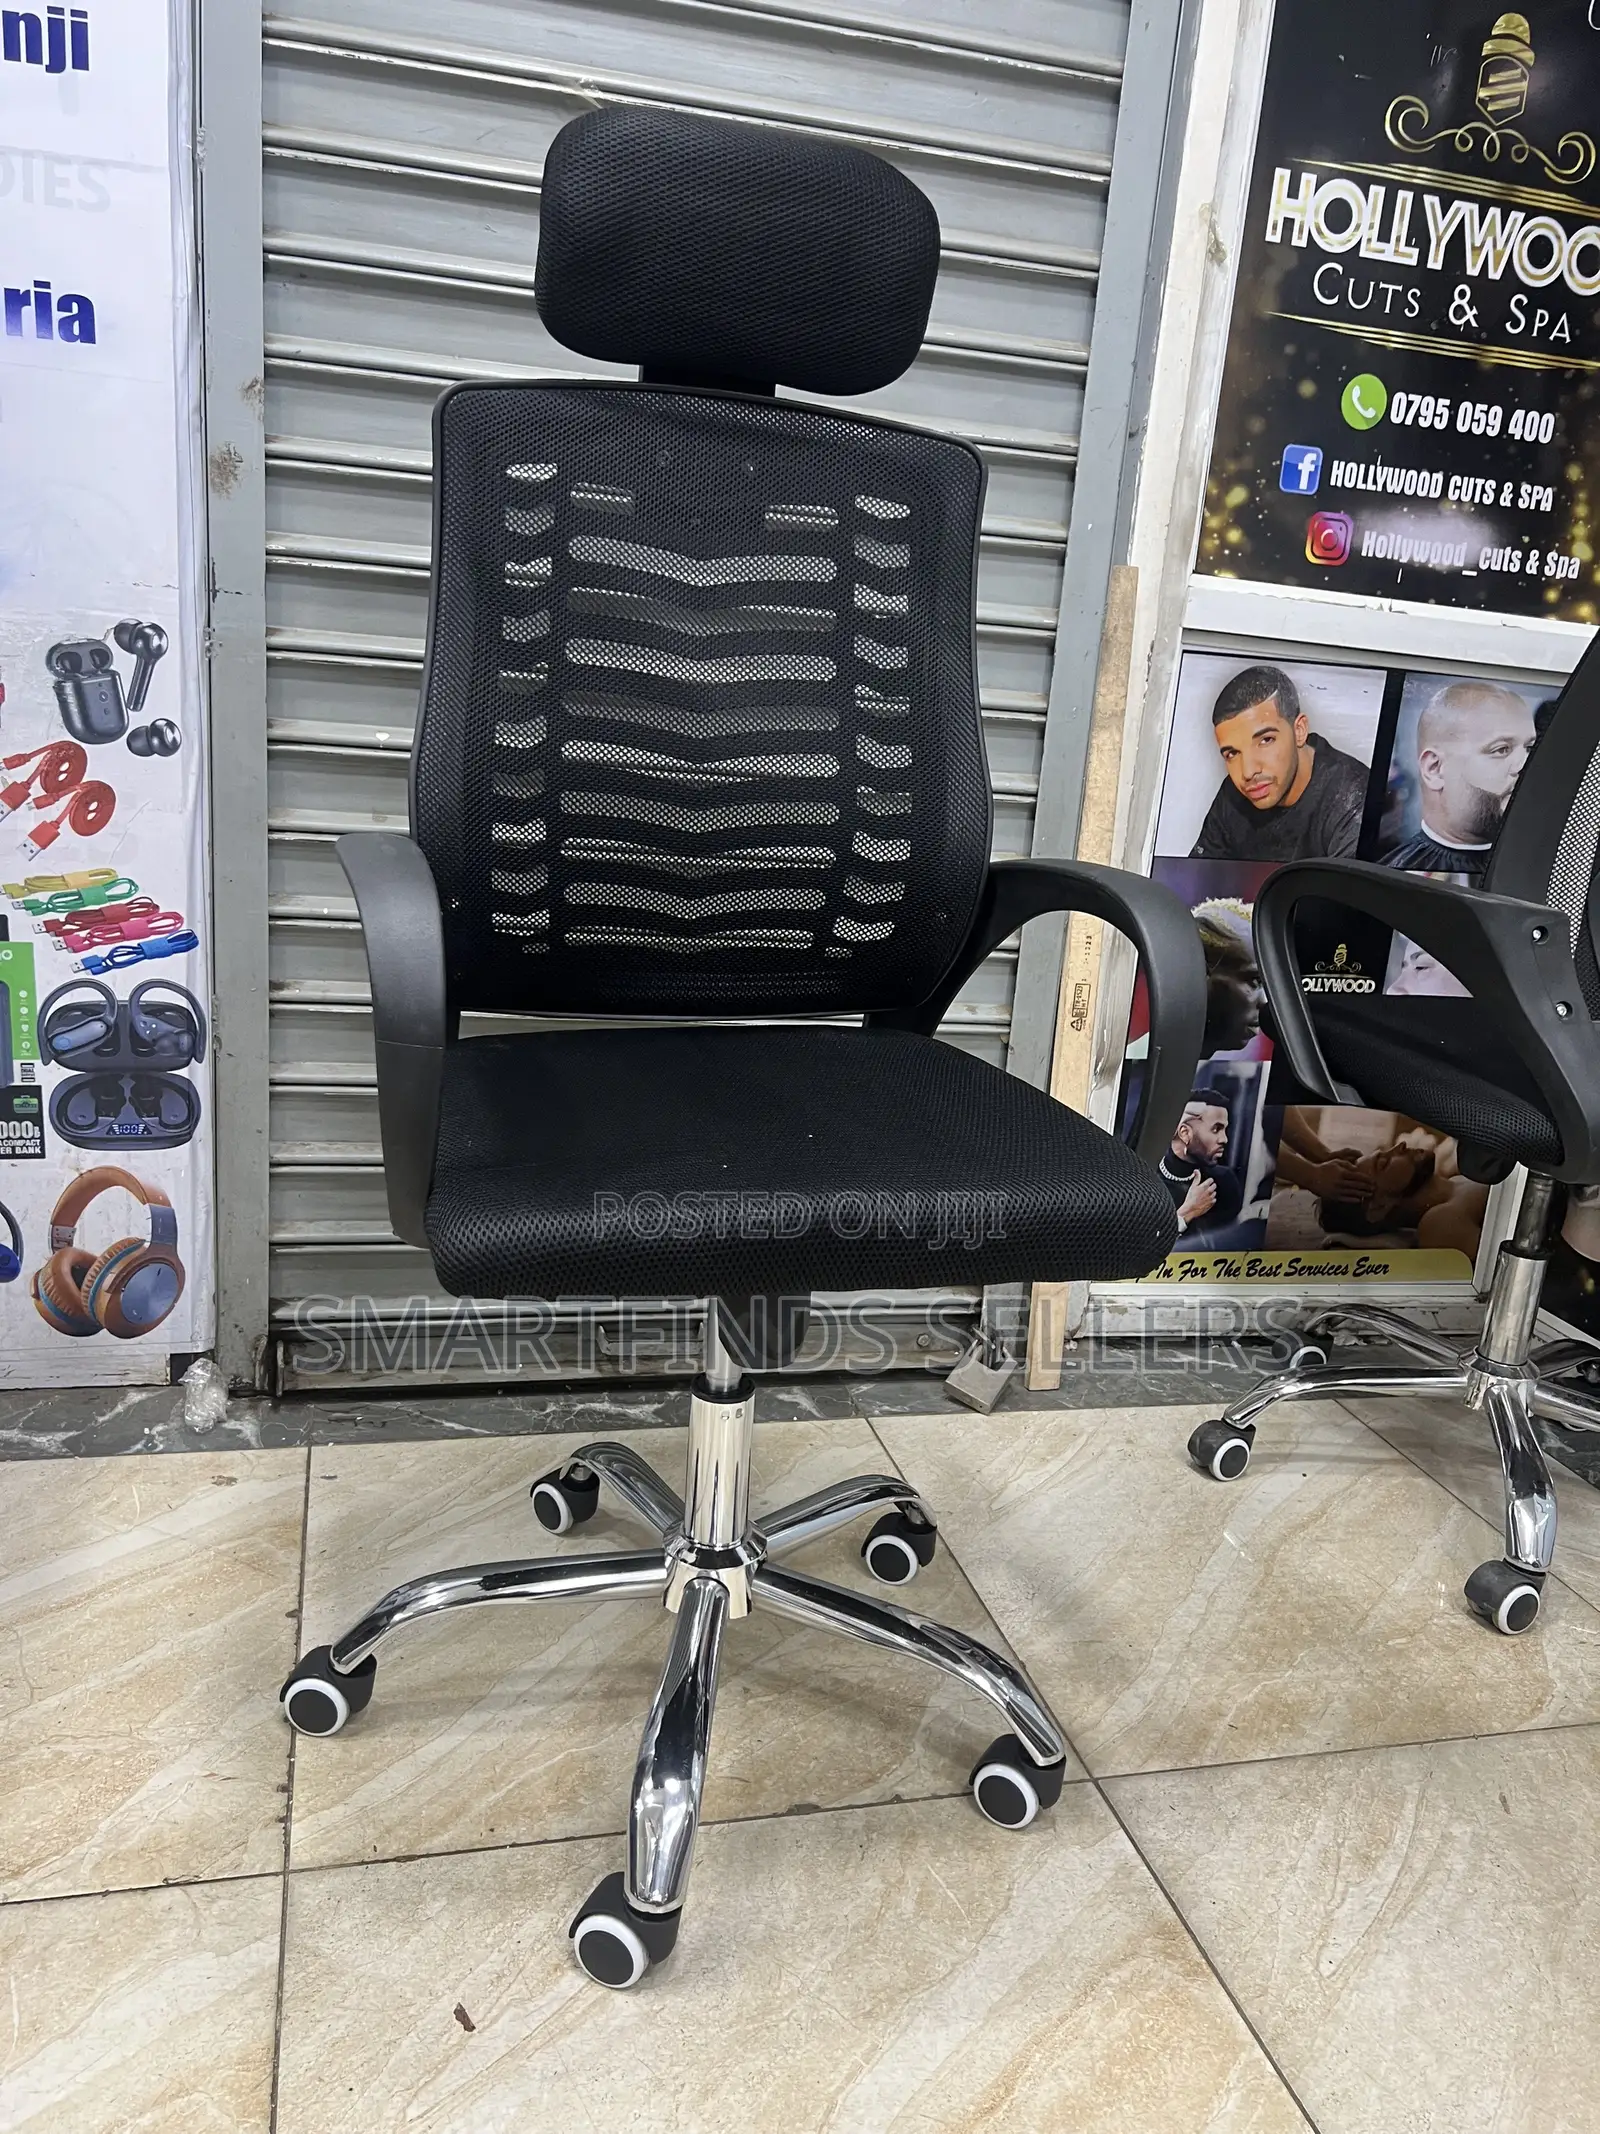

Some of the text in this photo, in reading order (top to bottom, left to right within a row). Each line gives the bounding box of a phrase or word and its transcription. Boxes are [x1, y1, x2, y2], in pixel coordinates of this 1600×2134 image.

[2, 5, 90, 74] nji
[4, 280, 96, 345] ria
[1448, 283, 1479, 328] &
[1390, 391, 1555, 444] 0795 059 400
[1330, 460, 1553, 512] HOLLYWOOD CUTS & SPA
[1525, 549, 1539, 575] &
[1543, 551, 1580, 580] Spa
[1301, 978, 1376, 993] OLLYWOOD
[15, 1146, 42, 1155] BANK
[1178, 1259, 1208, 1281] For
[1213, 1258, 1242, 1279] The
[1246, 1258, 1282, 1278] Best
[1284, 1257, 1349, 1278] Services
[1352, 1256, 1389, 1278] Ever
